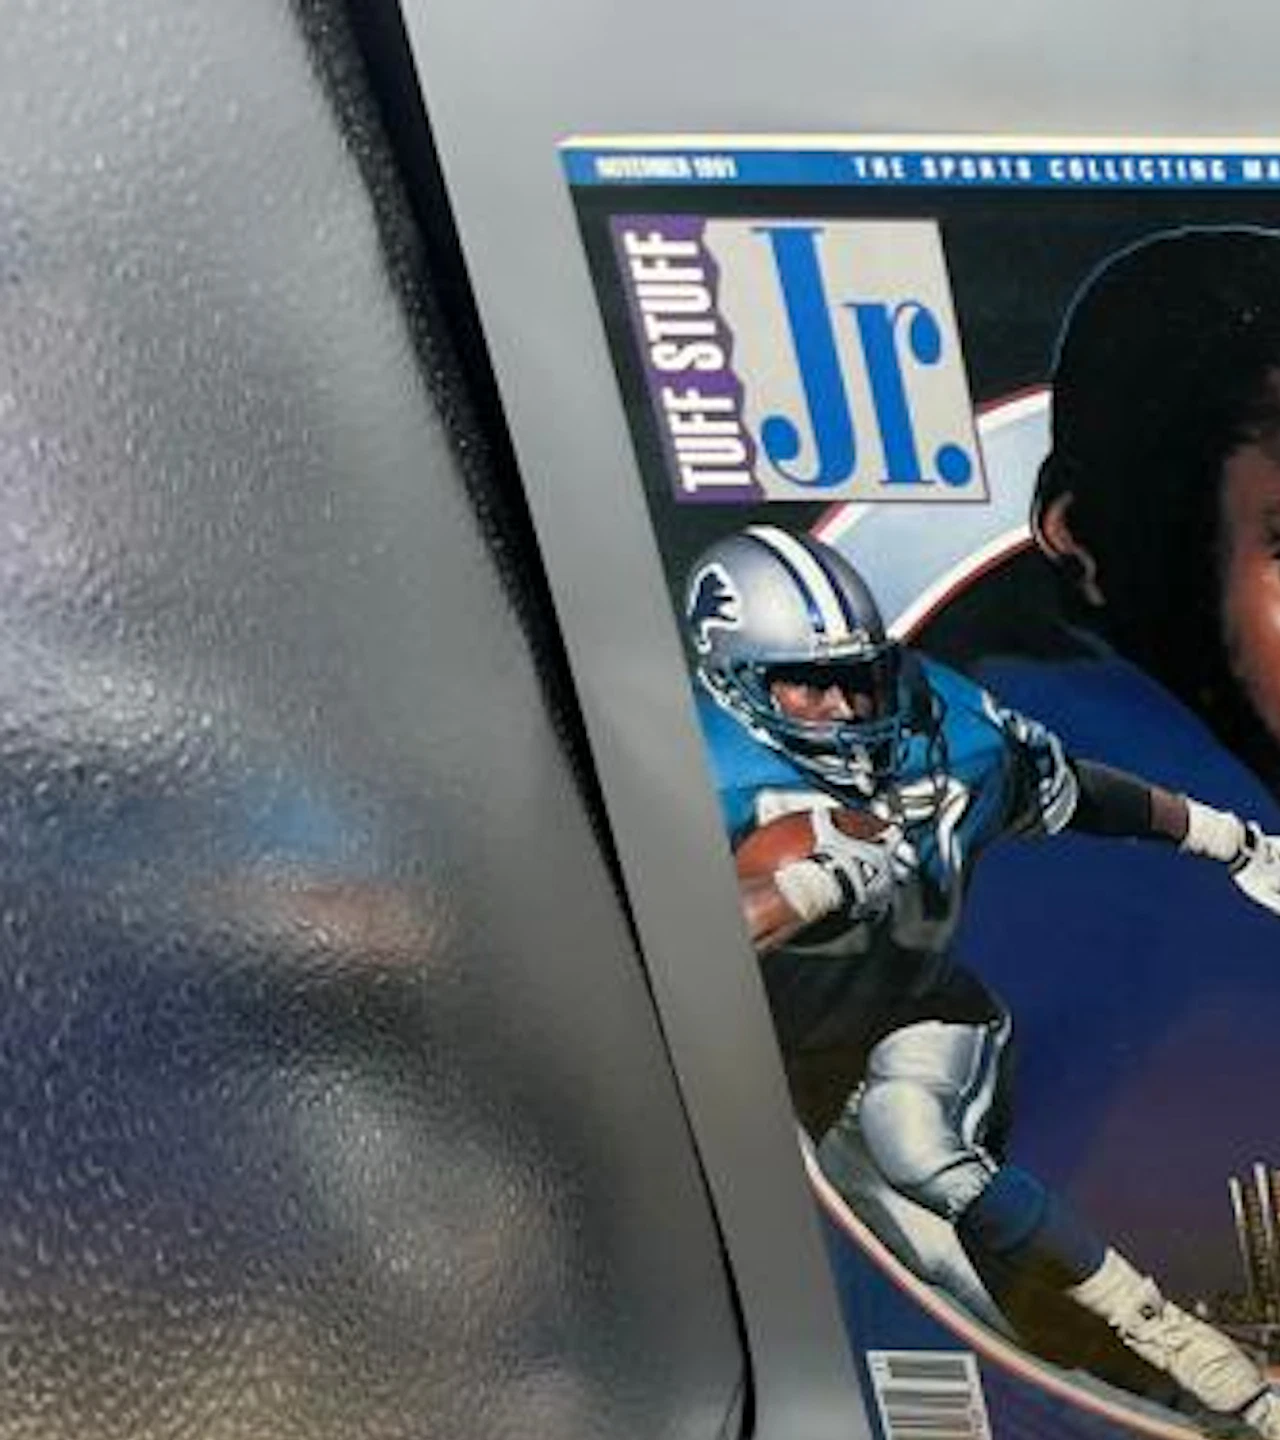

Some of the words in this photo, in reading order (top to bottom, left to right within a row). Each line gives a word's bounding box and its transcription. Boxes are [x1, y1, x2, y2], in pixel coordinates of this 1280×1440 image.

[1049, 157, 1228, 182] COLLECTING
[623, 228, 730, 374] STUFF
[750, 226, 975, 489] Jr.
[659, 385, 754, 494] TUFF
